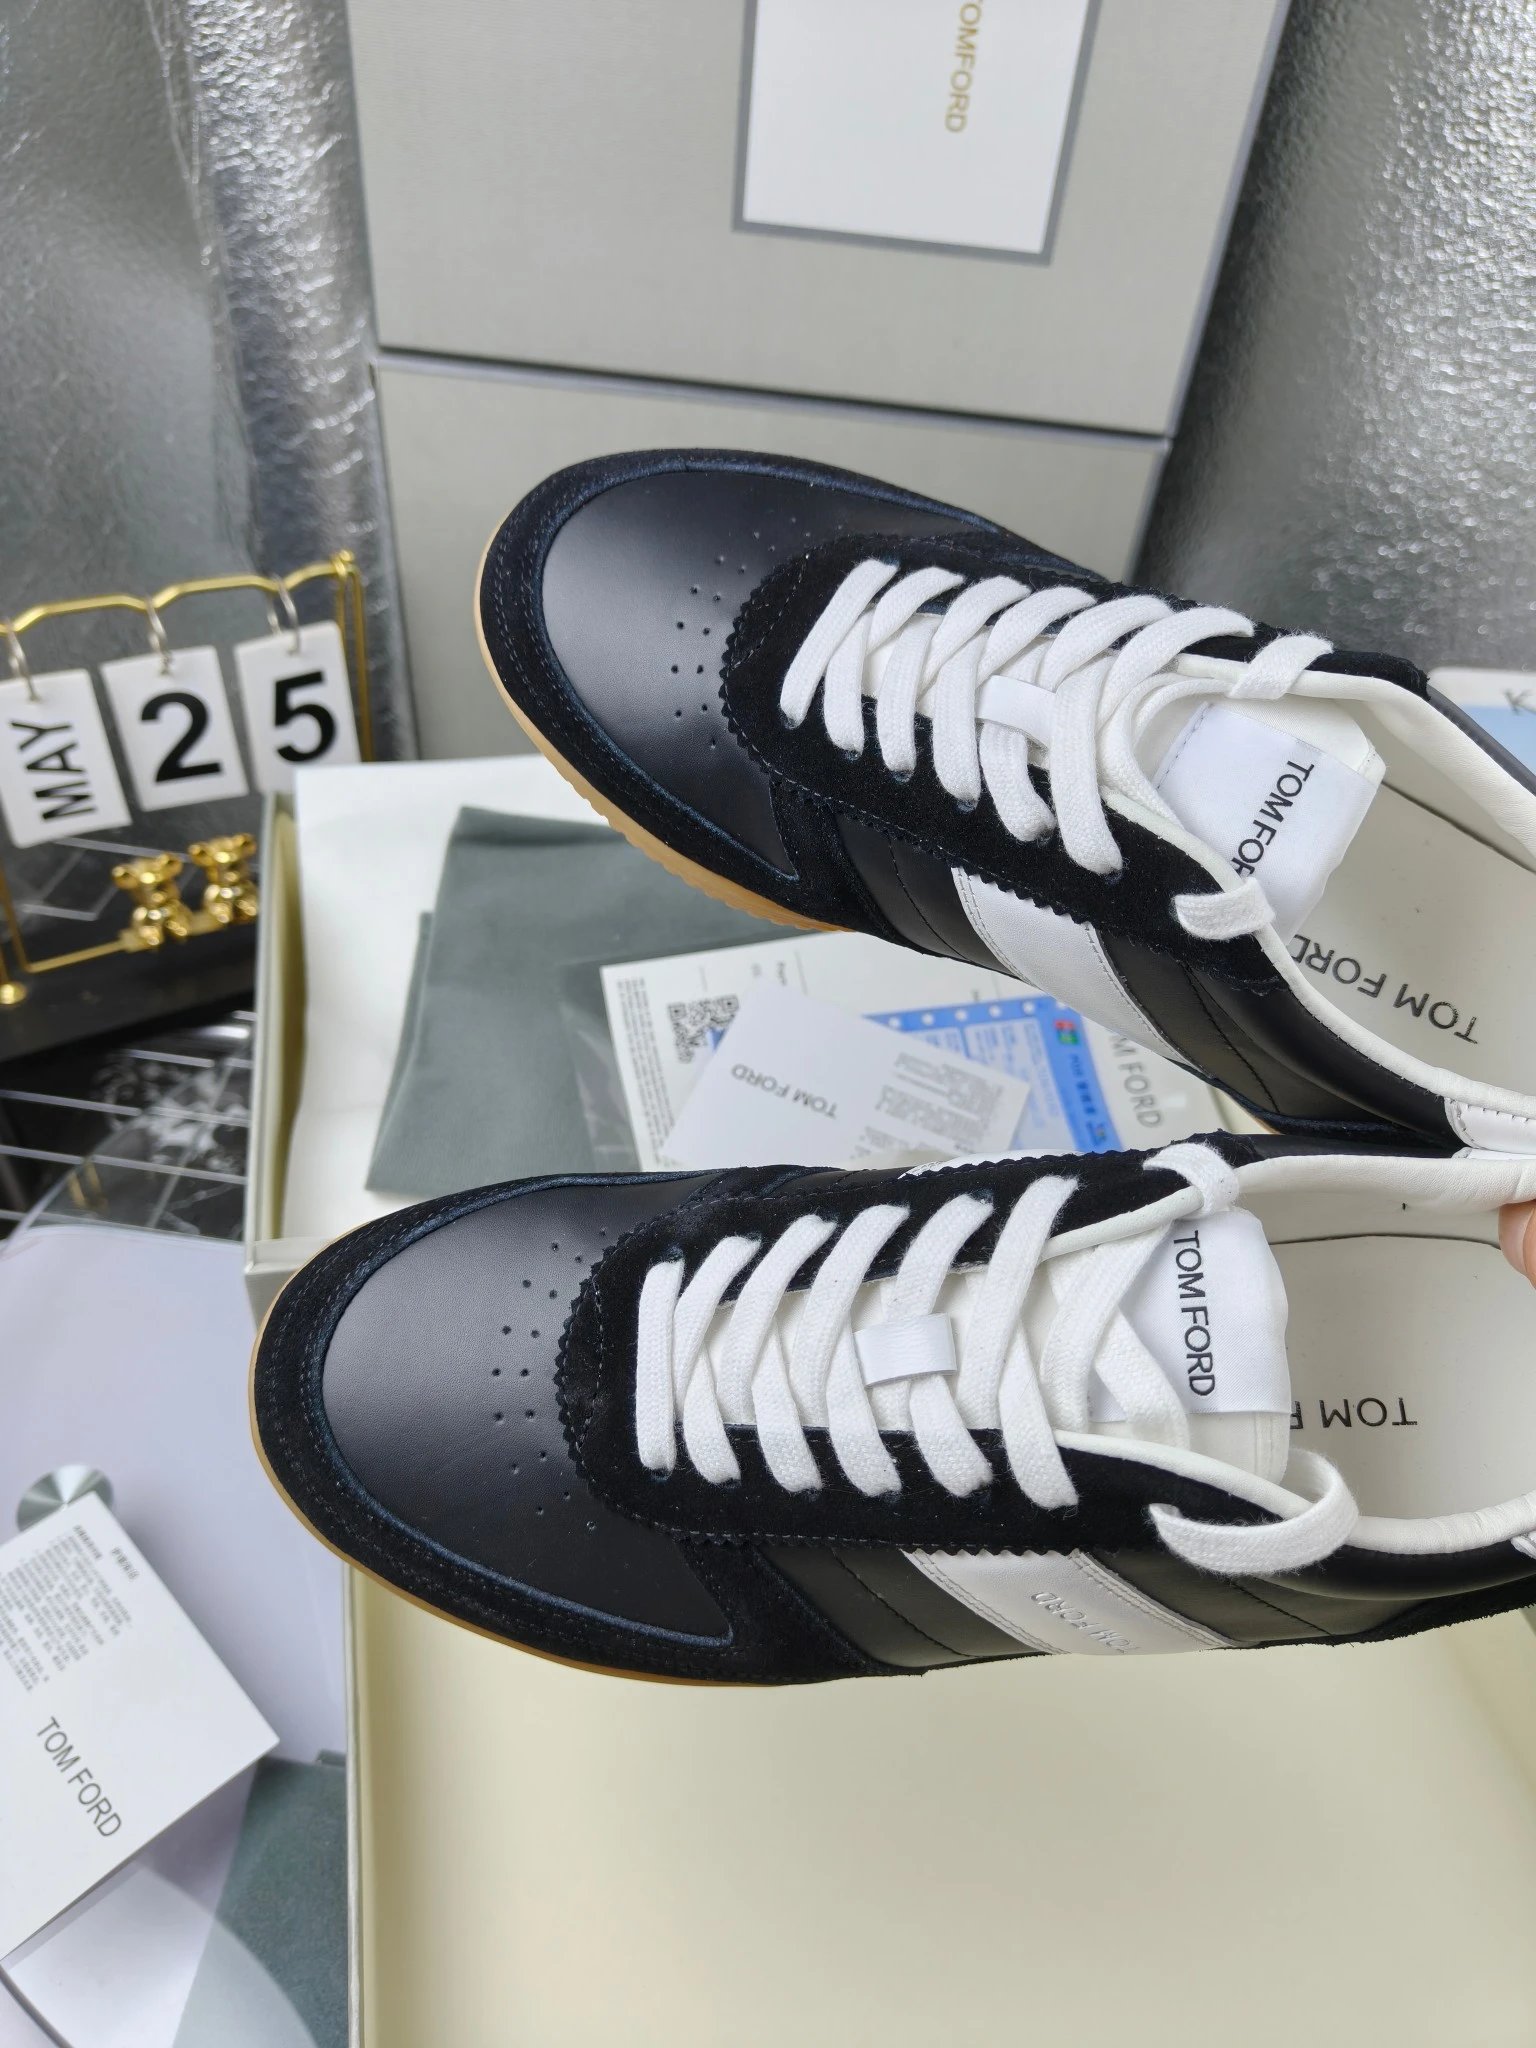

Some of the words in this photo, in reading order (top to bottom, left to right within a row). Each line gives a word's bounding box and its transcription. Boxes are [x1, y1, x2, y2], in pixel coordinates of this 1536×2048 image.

[944, 0, 984, 133] OMFORD
[11, 720, 96, 821] MAY
[141, 692, 223, 782] 2
[274, 671, 336, 762] 5
[1259, 759, 1315, 823] TOM
[1230, 818, 1278, 877] FOR
[1392, 982, 1479, 1045] TOM
[731, 1062, 791, 1099] FORD
[792, 1087, 838, 1121] TOM
[1117, 1060, 1165, 1129] FORD
[1173, 1229, 1206, 1299] TOM
[1180, 1305, 1216, 1397] FORD
[1318, 1396, 1418, 1429] TOM
[37, 1715, 82, 1774] TOM
[66, 1766, 123, 1838] FORD
